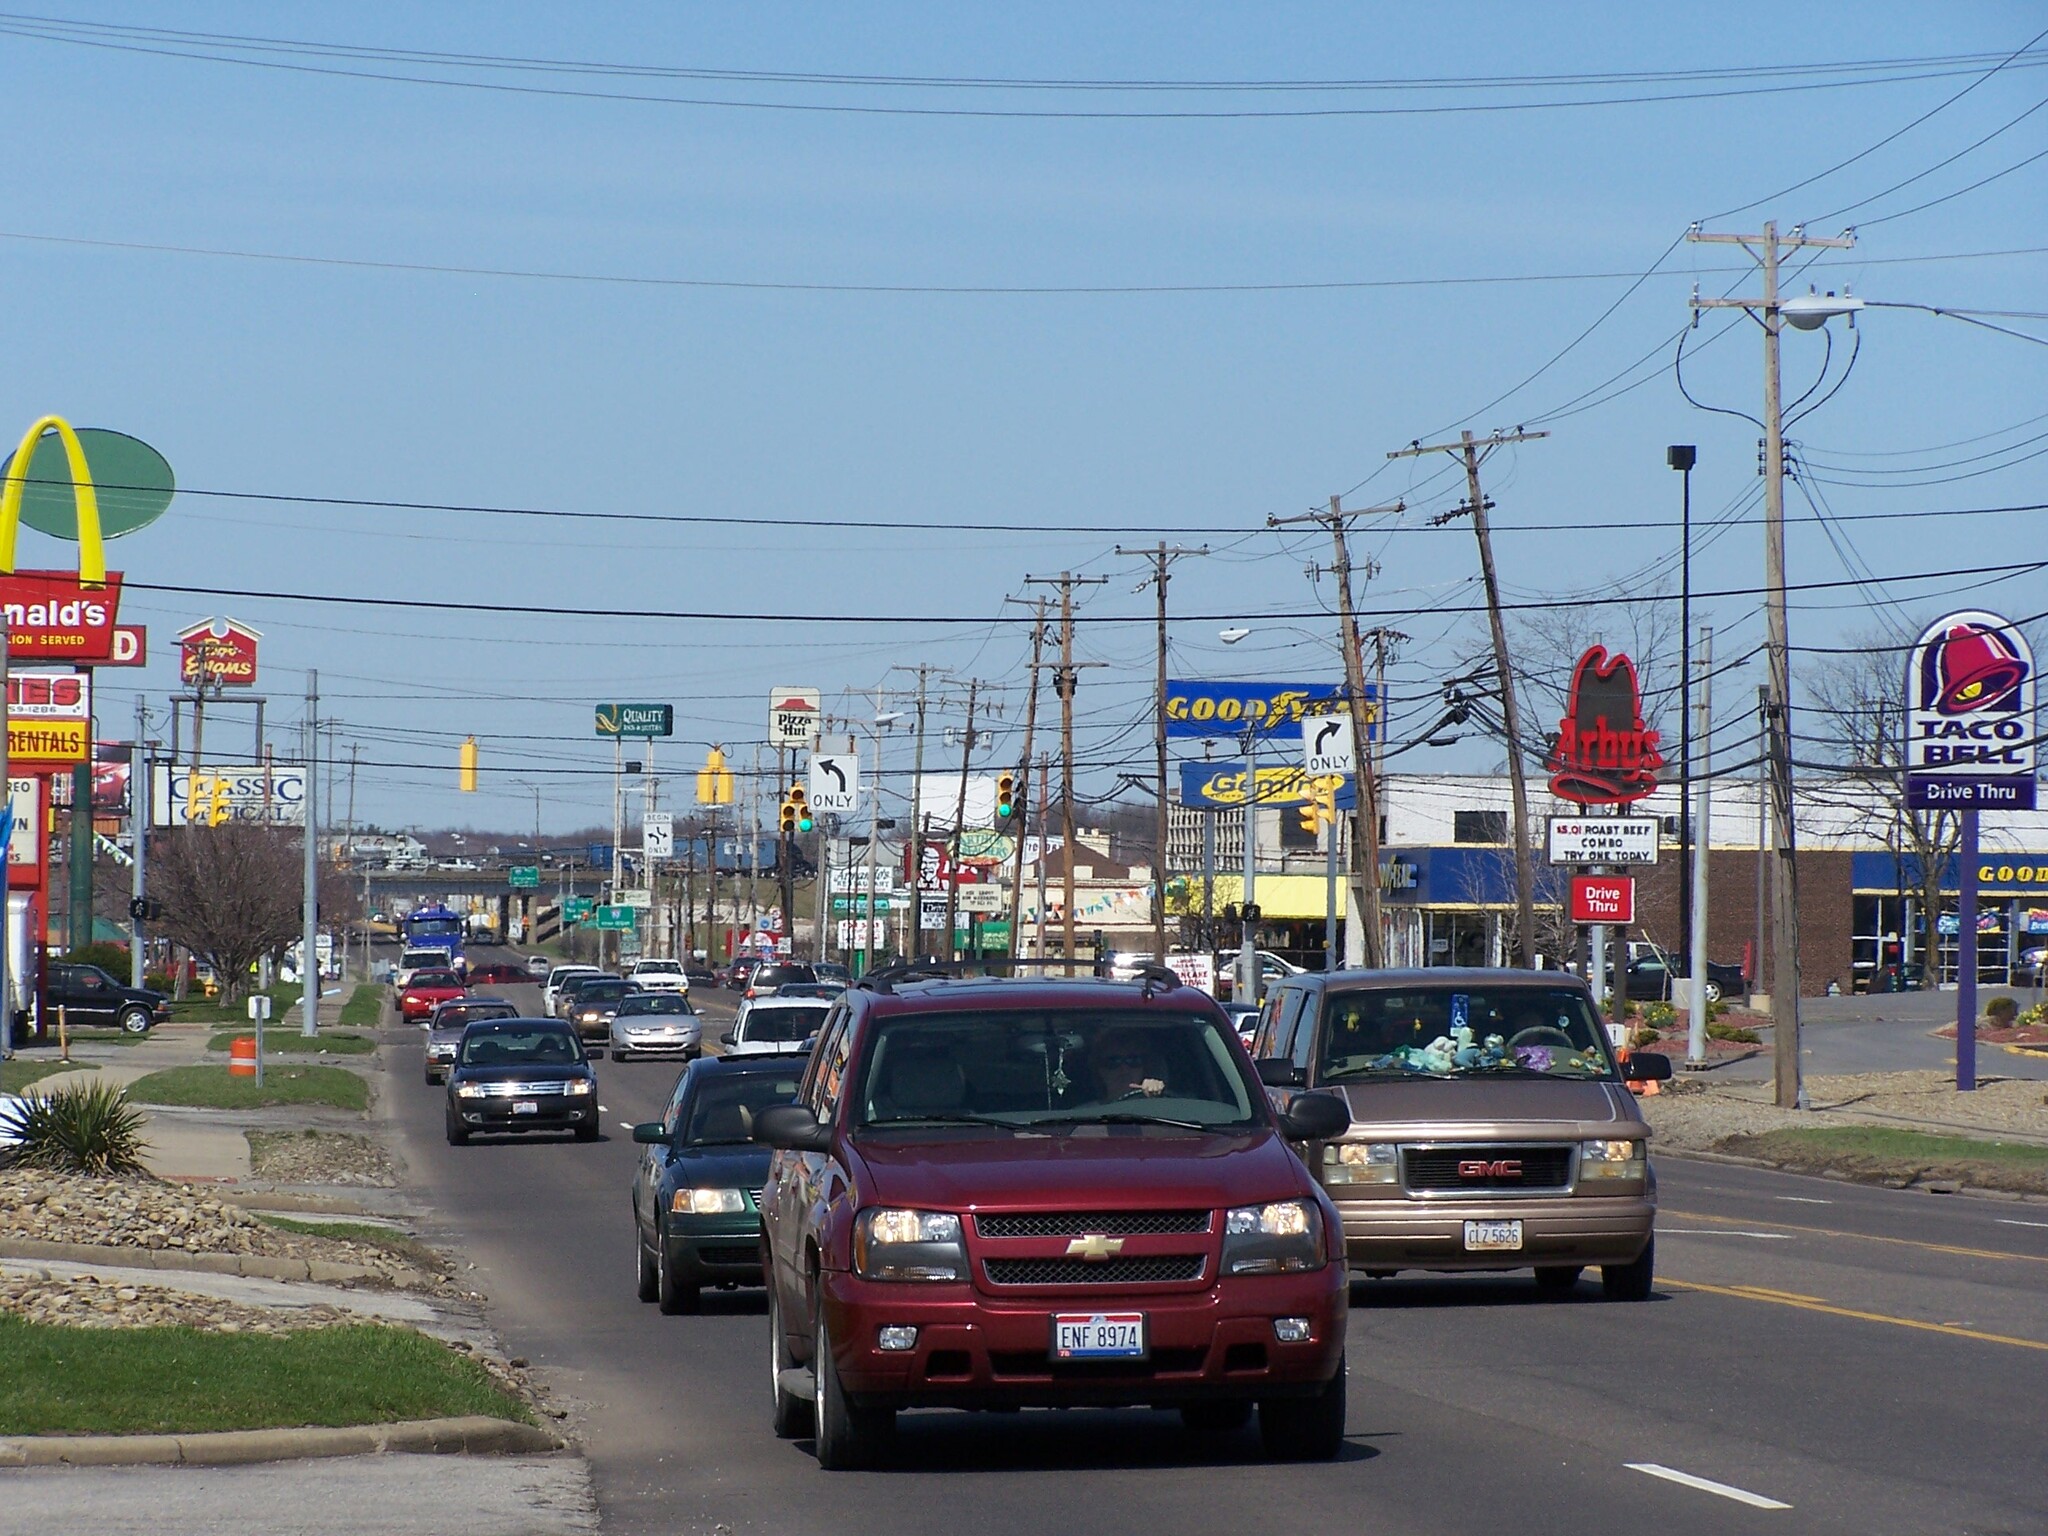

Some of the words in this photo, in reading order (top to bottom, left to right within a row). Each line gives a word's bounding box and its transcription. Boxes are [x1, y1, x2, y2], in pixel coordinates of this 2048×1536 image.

[0, 600, 106, 627] nald's
[8, 635, 33, 645] ION
[40, 635, 85, 645] SERVED
[623, 708, 664, 724] QUALITY
[778, 714, 812, 726] Pizza
[779, 724, 806, 736] Hut
[1916, 720, 2024, 740] TACO
[8, 730, 80, 753] RENTALS
[1547, 714, 1664, 782] Arby's
[1923, 744, 2025, 765] BELL
[1310, 755, 1349, 771] ONLY
[1210, 772, 1313, 795] Gemin
[1927, 782, 1973, 799] Drive
[1977, 783, 2016, 799] Thru
[813, 794, 853, 808] ONLY
[1585, 825, 1620, 835] ROAST
[1623, 825, 1651, 835] BEEF
[648, 846, 669, 854] ONLY
[1581, 838, 1623, 848] COMBO
[1563, 850, 1585, 860] TRY
[1588, 851, 1611, 860] ONE
[1616, 851, 1650, 860] TODAY
[1978, 866, 2048, 882] GOOD
[1585, 886, 1620, 899] Drive
[1588, 900, 1619, 912] Thru
[1175, 971, 1208, 979] NCAKE
[1458, 1160, 1522, 1177] GMC
[1469, 1229, 1489, 1244] CLZ
[1492, 1228, 1518, 1243] 5626
[1061, 1326, 1091, 1348] ENF
[1097, 1326, 1137, 1347] 8974
